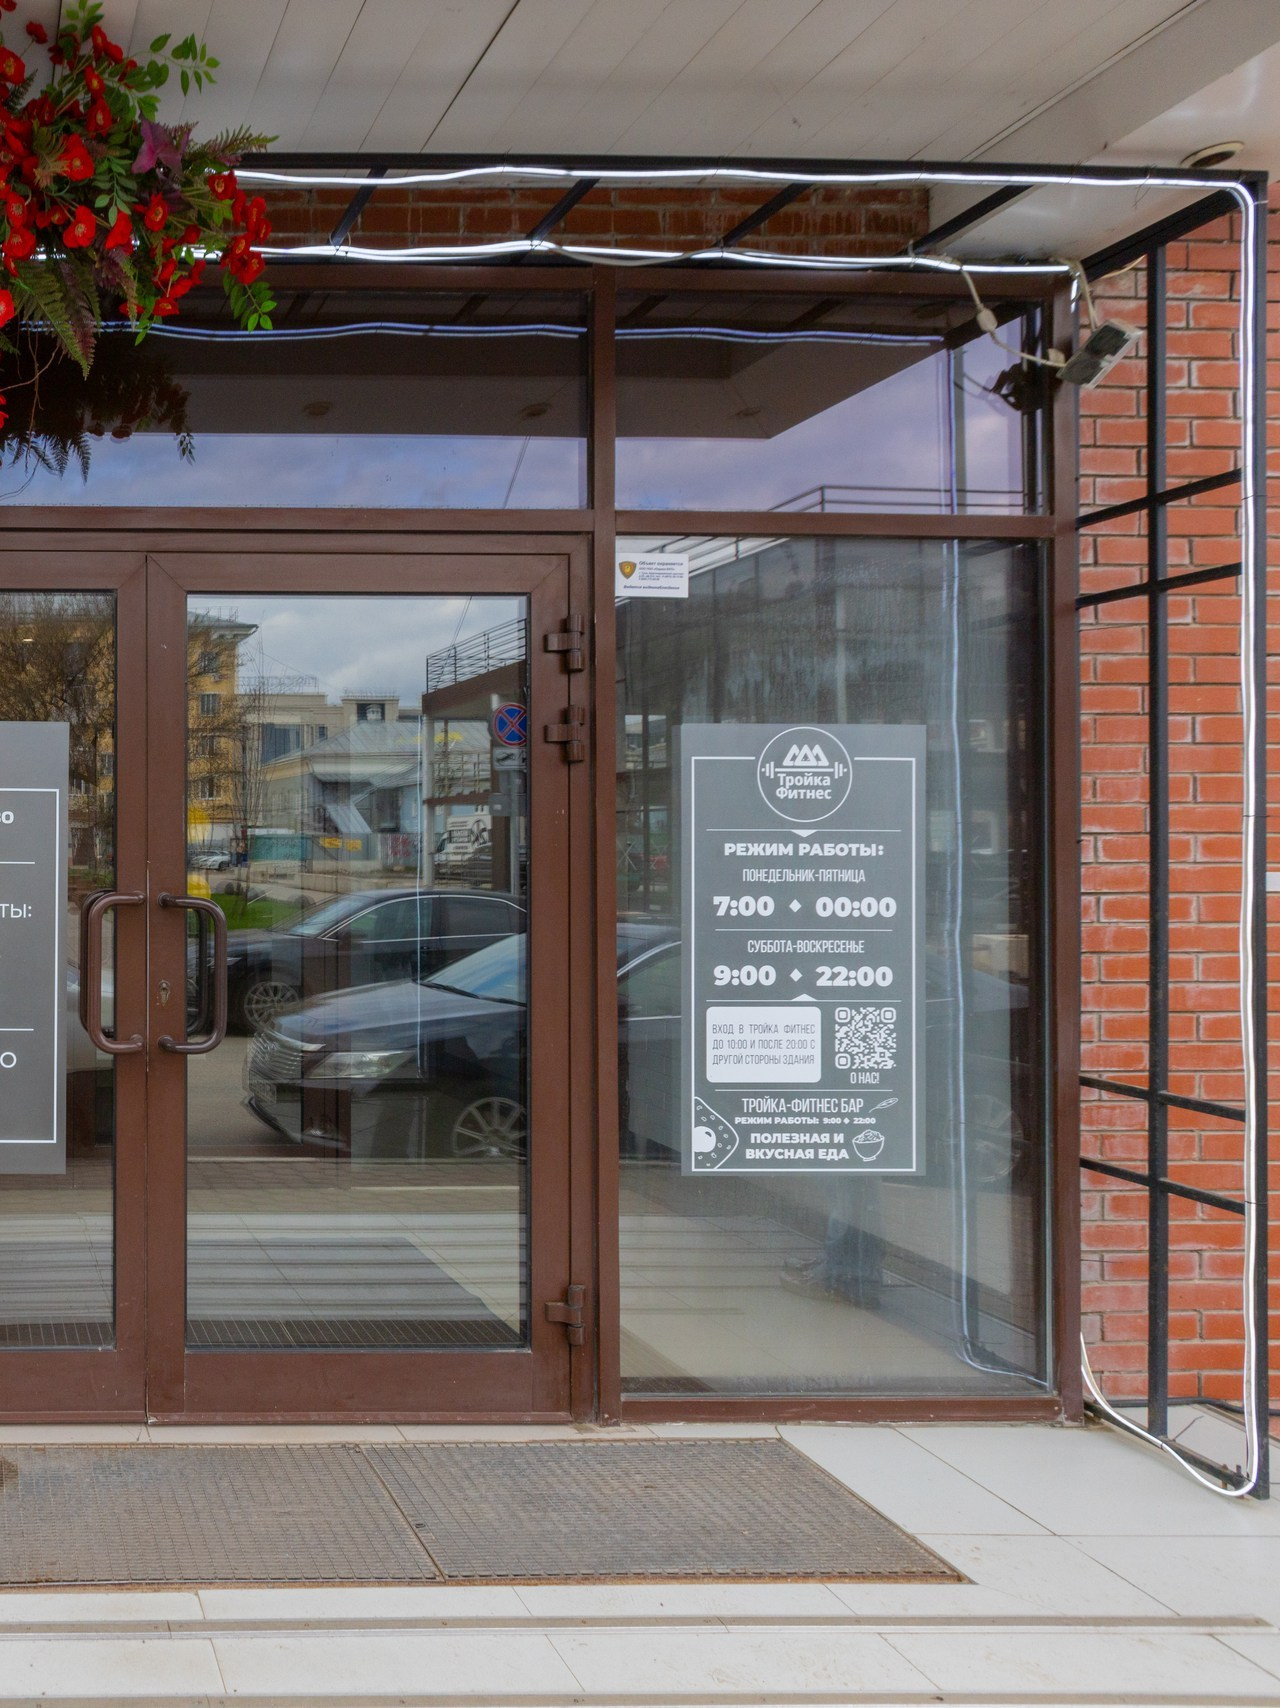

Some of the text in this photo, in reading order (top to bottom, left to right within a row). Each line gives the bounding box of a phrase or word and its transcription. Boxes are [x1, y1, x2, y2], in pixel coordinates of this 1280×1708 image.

[777, 773, 831, 790] Тройка
[775, 787, 832, 800] Фитнес
[724, 844, 884, 857] РЕЖИМ РАБОТЫ:
[742, 869, 866, 884] ПОНЕДЕЛЬНИК-ПЯТНИЦА
[713, 896, 897, 918] 7:00 00:00
[747, 940, 865, 954] СУББОТА-ВОСКРЕСЕНЬЕ
[713, 966, 893, 987] 9:00 22:00
[712, 1022, 816, 1035] ВХОД В ТРОЙКА ФИТНЕС
[711, 1038, 816, 1051] ДО 10:00 И ПОСЛЕ 20:00 С
[712, 1054, 815, 1066] ДРУГОЙ СТОРОНЫ ЗДАНИЯ
[849, 1072, 880, 1085] О НАС!
[741, 1095, 864, 1113] ТРОЙКА-ФИТНЕС БАР
[734, 1116, 877, 1125] РЕЖИМ РАБОТЫ: 9:00 22:00
[750, 1132, 845, 1144] ПОЛЕЗНАЯ И
[745, 1148, 850, 1161] ВКУСНАЯ ЕДА
